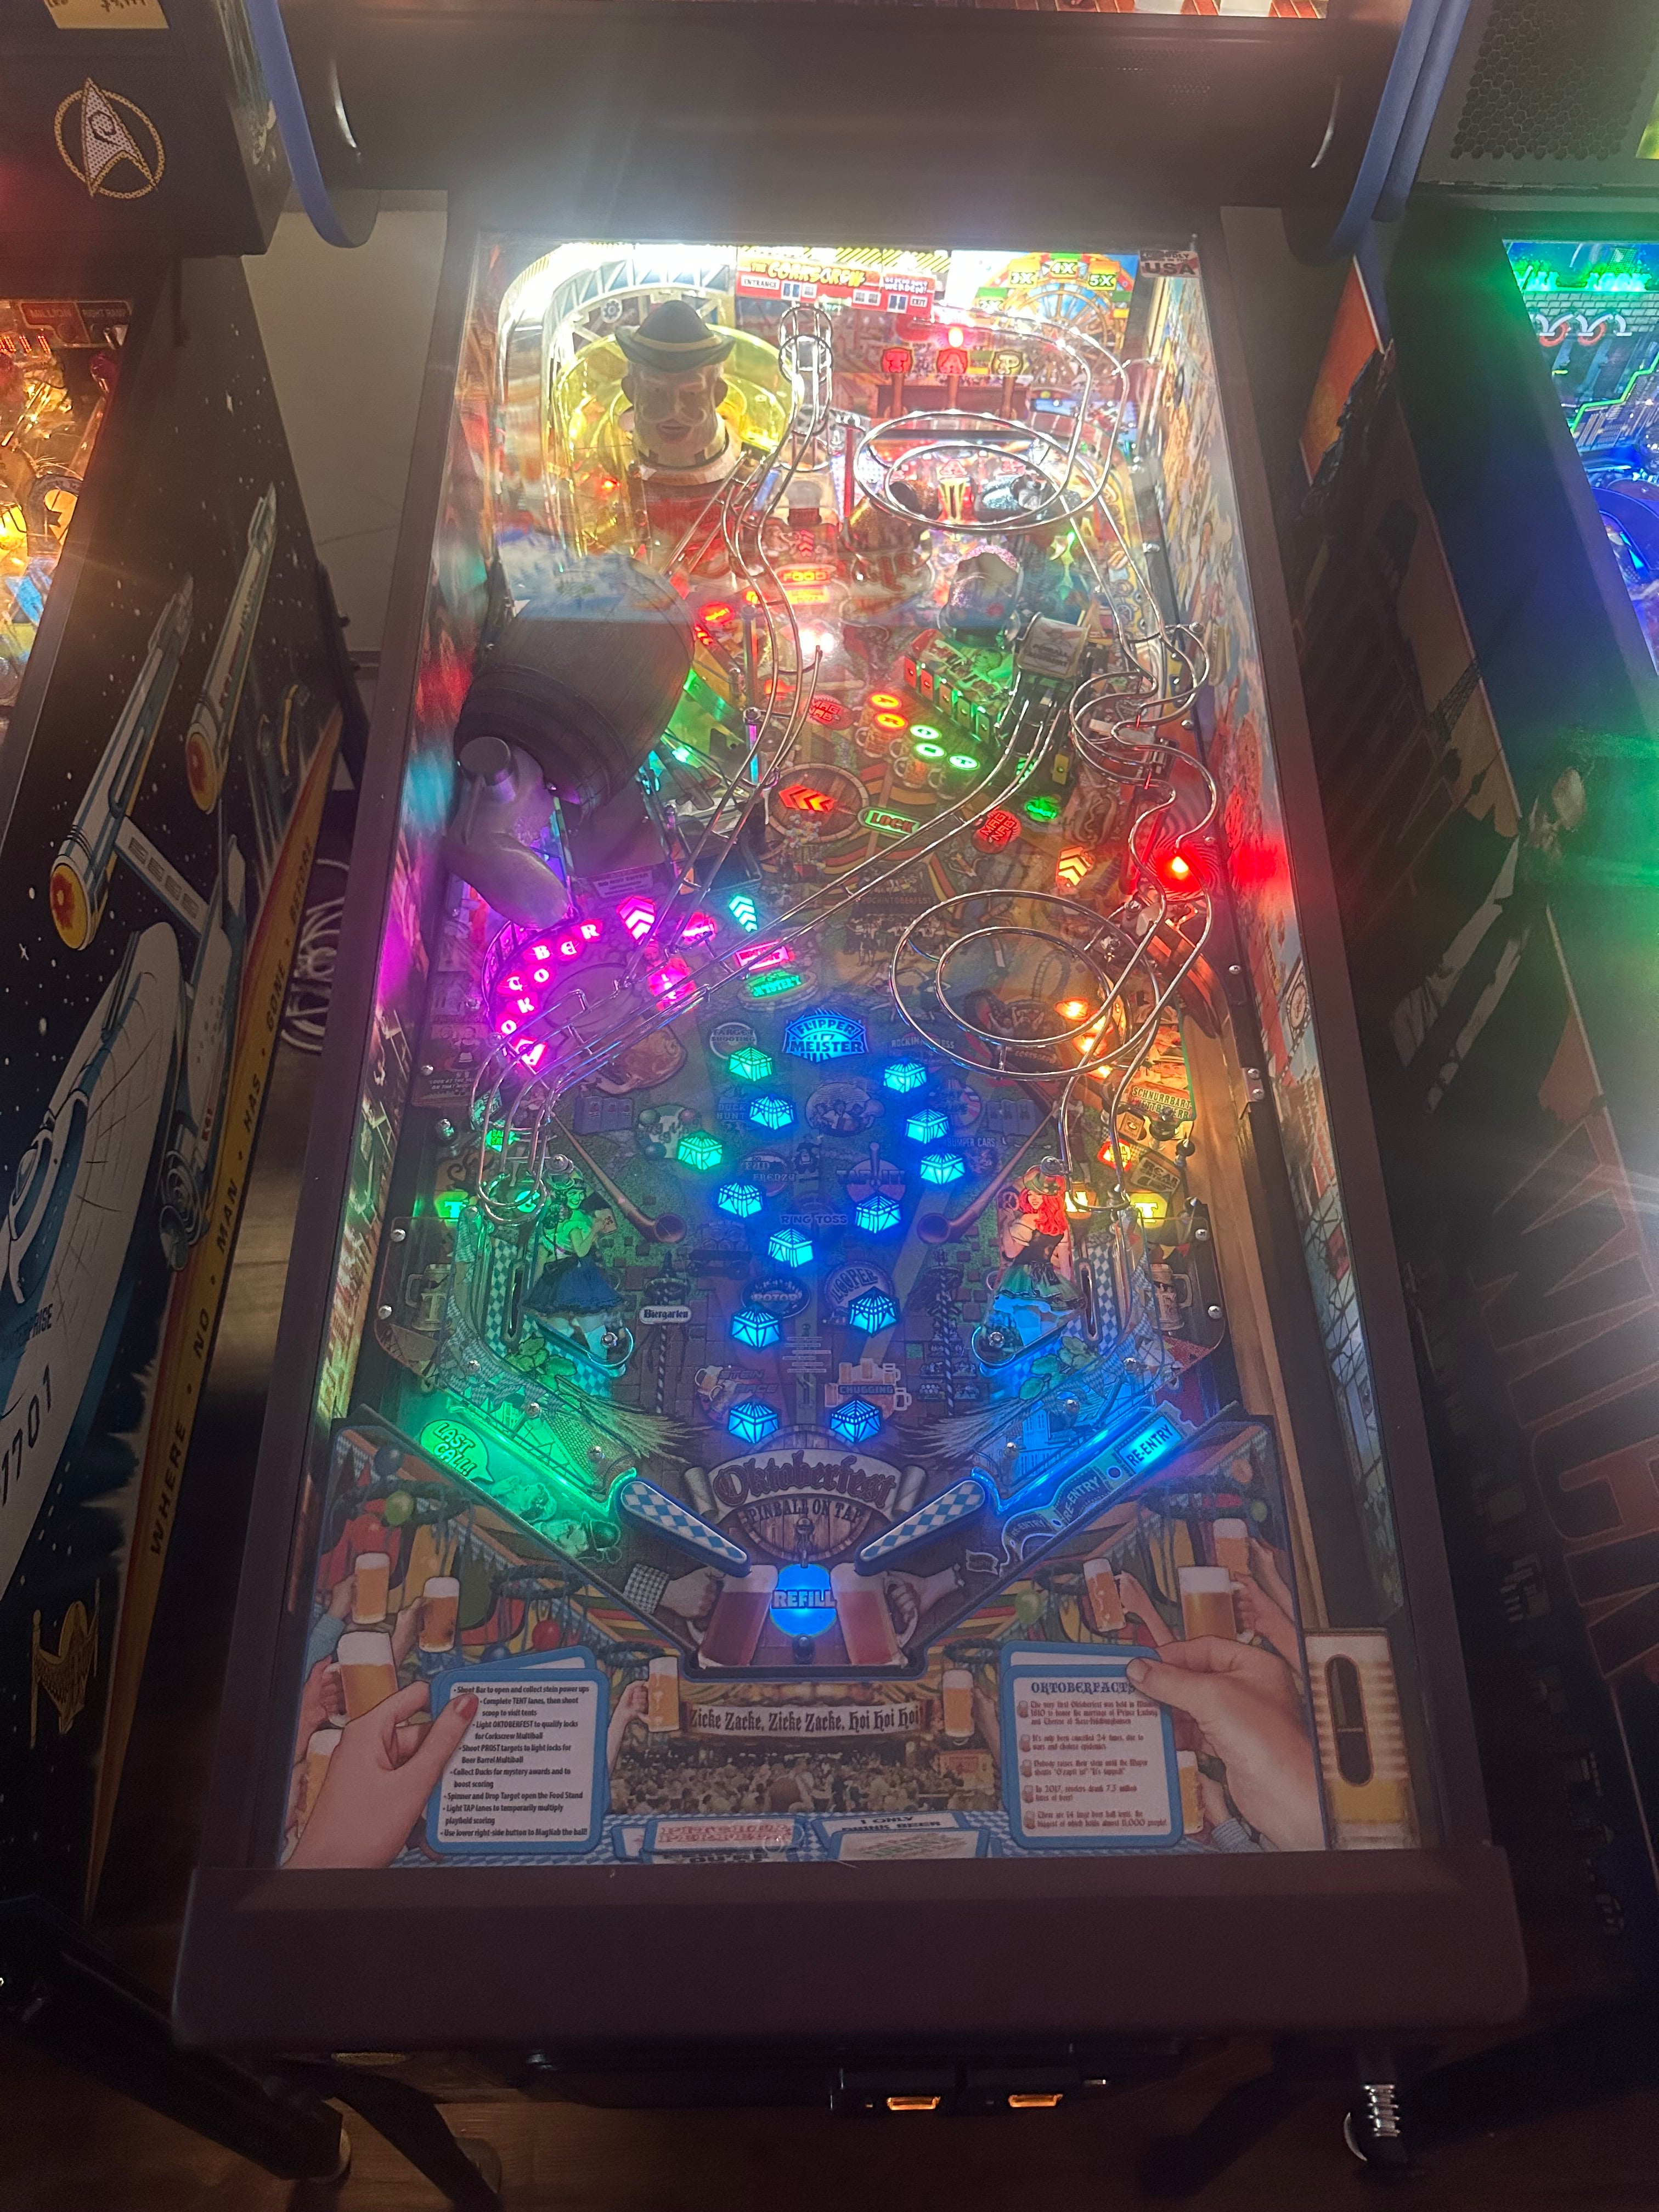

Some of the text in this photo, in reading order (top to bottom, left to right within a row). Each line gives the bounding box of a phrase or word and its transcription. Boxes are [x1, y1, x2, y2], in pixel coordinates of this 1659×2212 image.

[1051, 261, 1076, 274] 4X
[1145, 263, 1195, 275] USA
[744, 279, 777, 289] ENTRANCE
[1010, 272, 1034, 285] 3X
[1088, 274, 1114, 287] 5X
[783, 572, 826, 582] FOOD
[871, 812, 915, 834] LOCK
[981, 813, 1007, 836] MAG
[994, 819, 1017, 842] NAB
[797, 1019, 859, 1035] FLIPPER
[790, 1041, 864, 1053] MEISTER
[978, 1138, 996, 1147] CARS
[444, 1200, 465, 1222] T
[1135, 1202, 1158, 1223] T
[780, 1215, 848, 1224] RING TOSS
[150, 1421, 186, 1557] WHERE
[193, 1308, 210, 1358] NO
[216, 1180, 239, 1255] MAN
[244, 1076, 262, 1133] HAS
[267, 960, 286, 1034] GONE
[832, 1267, 879, 1304] LOOPER
[644, 1308, 689, 1319] Biergarten
[719, 1370, 764, 1379] STEIN
[735, 1384, 779, 1393] RACE
[839, 1385, 895, 1394] CHUGGING
[433, 1422, 476, 1453] LAST
[1126, 1424, 1173, 1466] RE-ENTRY
[433, 1442, 477, 1476] CALL!
[713, 1449, 896, 1508] Oktoberfest
[1062, 1476, 1102, 1520] RE-ENTRY
[747, 1497, 862, 1525] PINBALL ON TAP
[772, 1590, 836, 1609] REFILL
[1031, 1681, 1136, 1695] OKTOBERFACTS
[542, 1720, 561, 1729] qualify
[691, 1707, 721, 1730] Zicke
[725, 1711, 764, 1732] Zacke,
[769, 1711, 802, 1732] Zicke
[805, 1711, 845, 1733] Zacke,
[448, 1793, 471, 1801] Spinner
[485, 1792, 499, 1801] Drop
[501, 1792, 520, 1801] Target
[447, 1804, 462, 1813] Light
[501, 1804, 537, 1813] temporarily
[445, 1818, 472, 1826] playfield
[475, 1829, 505, 1837] right-side
